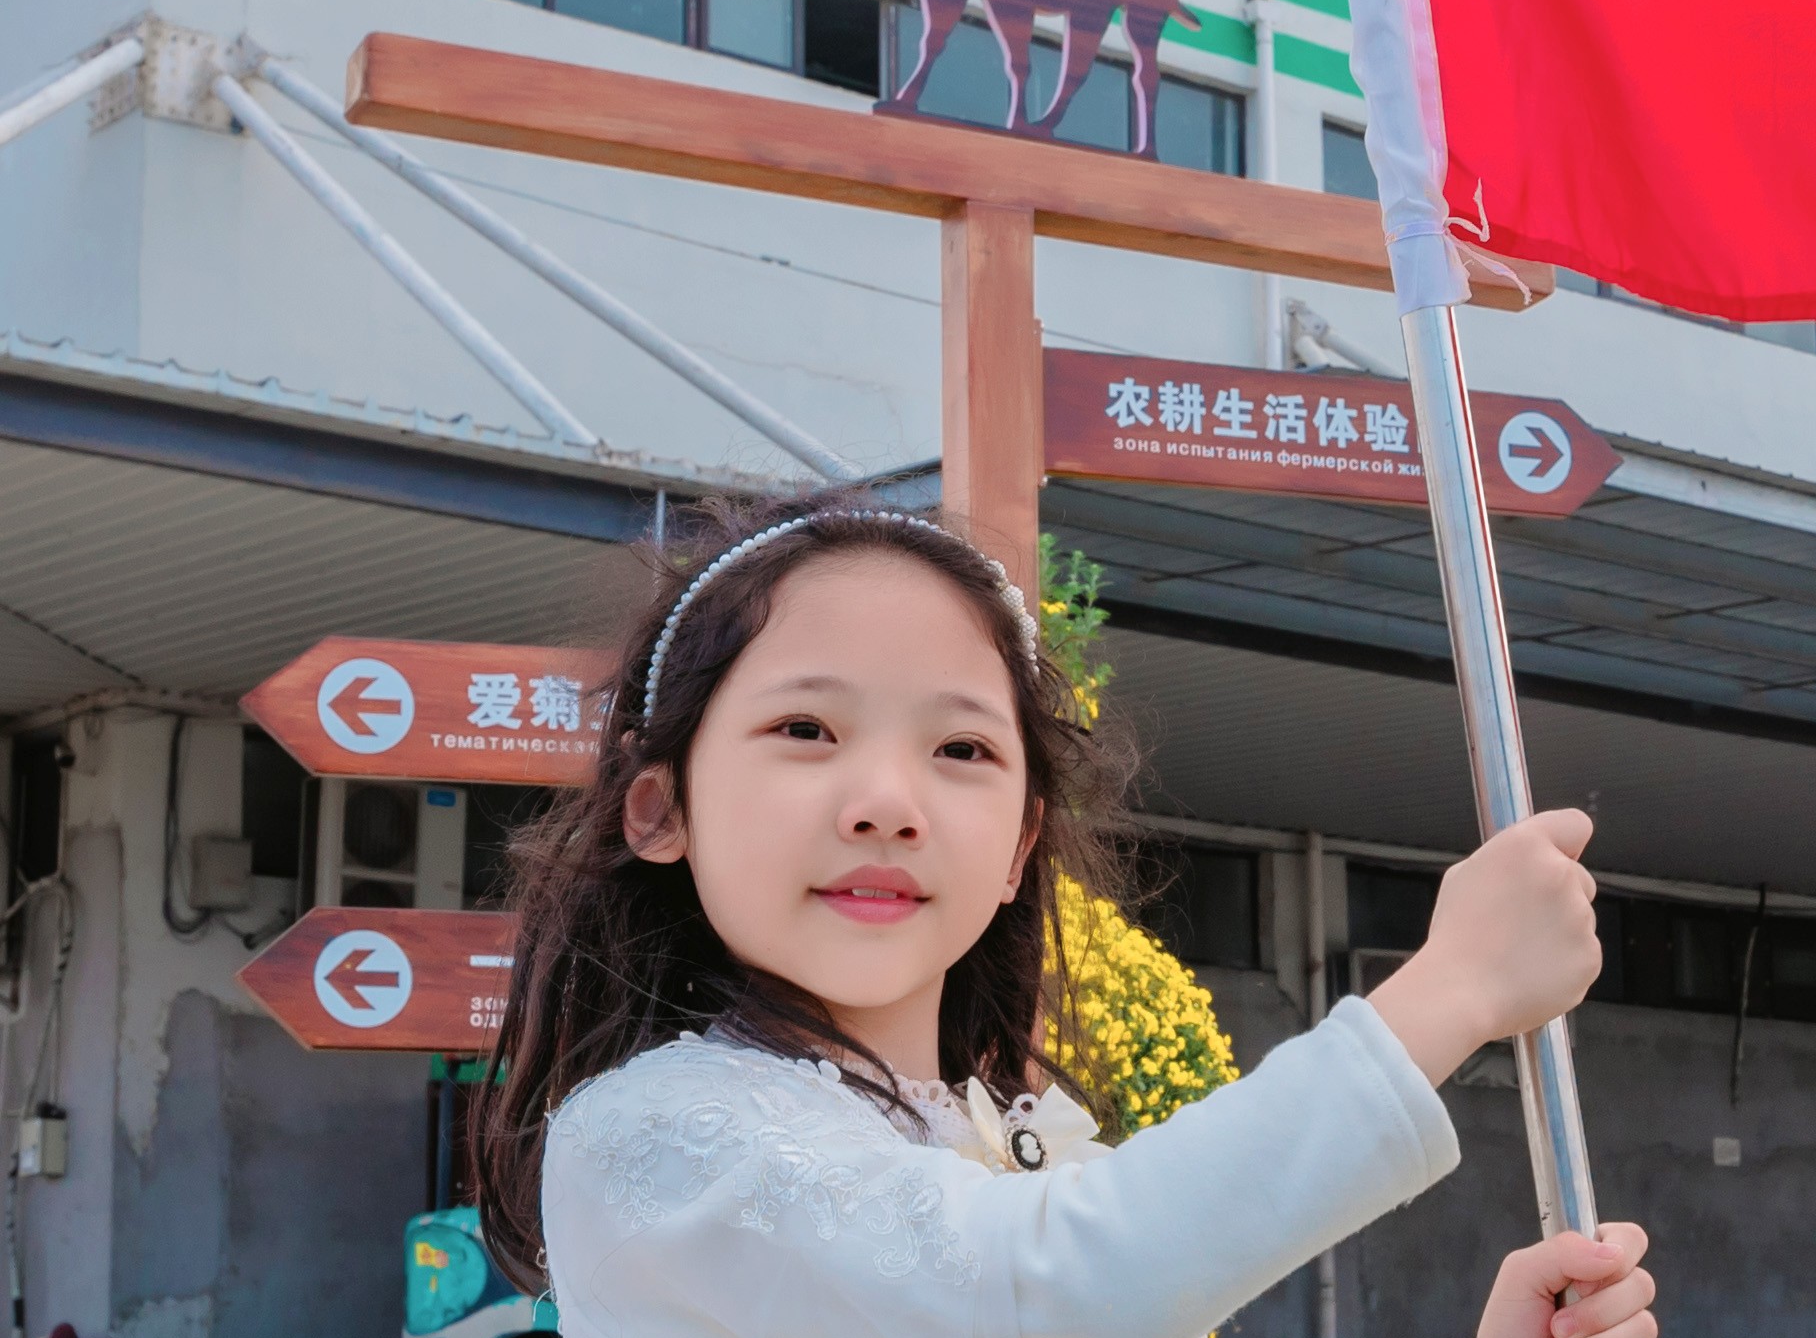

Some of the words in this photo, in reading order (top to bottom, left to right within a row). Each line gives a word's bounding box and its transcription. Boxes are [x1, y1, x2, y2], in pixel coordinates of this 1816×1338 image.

[1105, 376, 1421, 454] 农耕生活体验
[1113, 436, 1161, 454] зона
[1166, 441, 1273, 464] испытания
[1276, 449, 1393, 475] фермерской
[1397, 463, 1425, 477] жи
[469, 1012, 504, 1029] од
